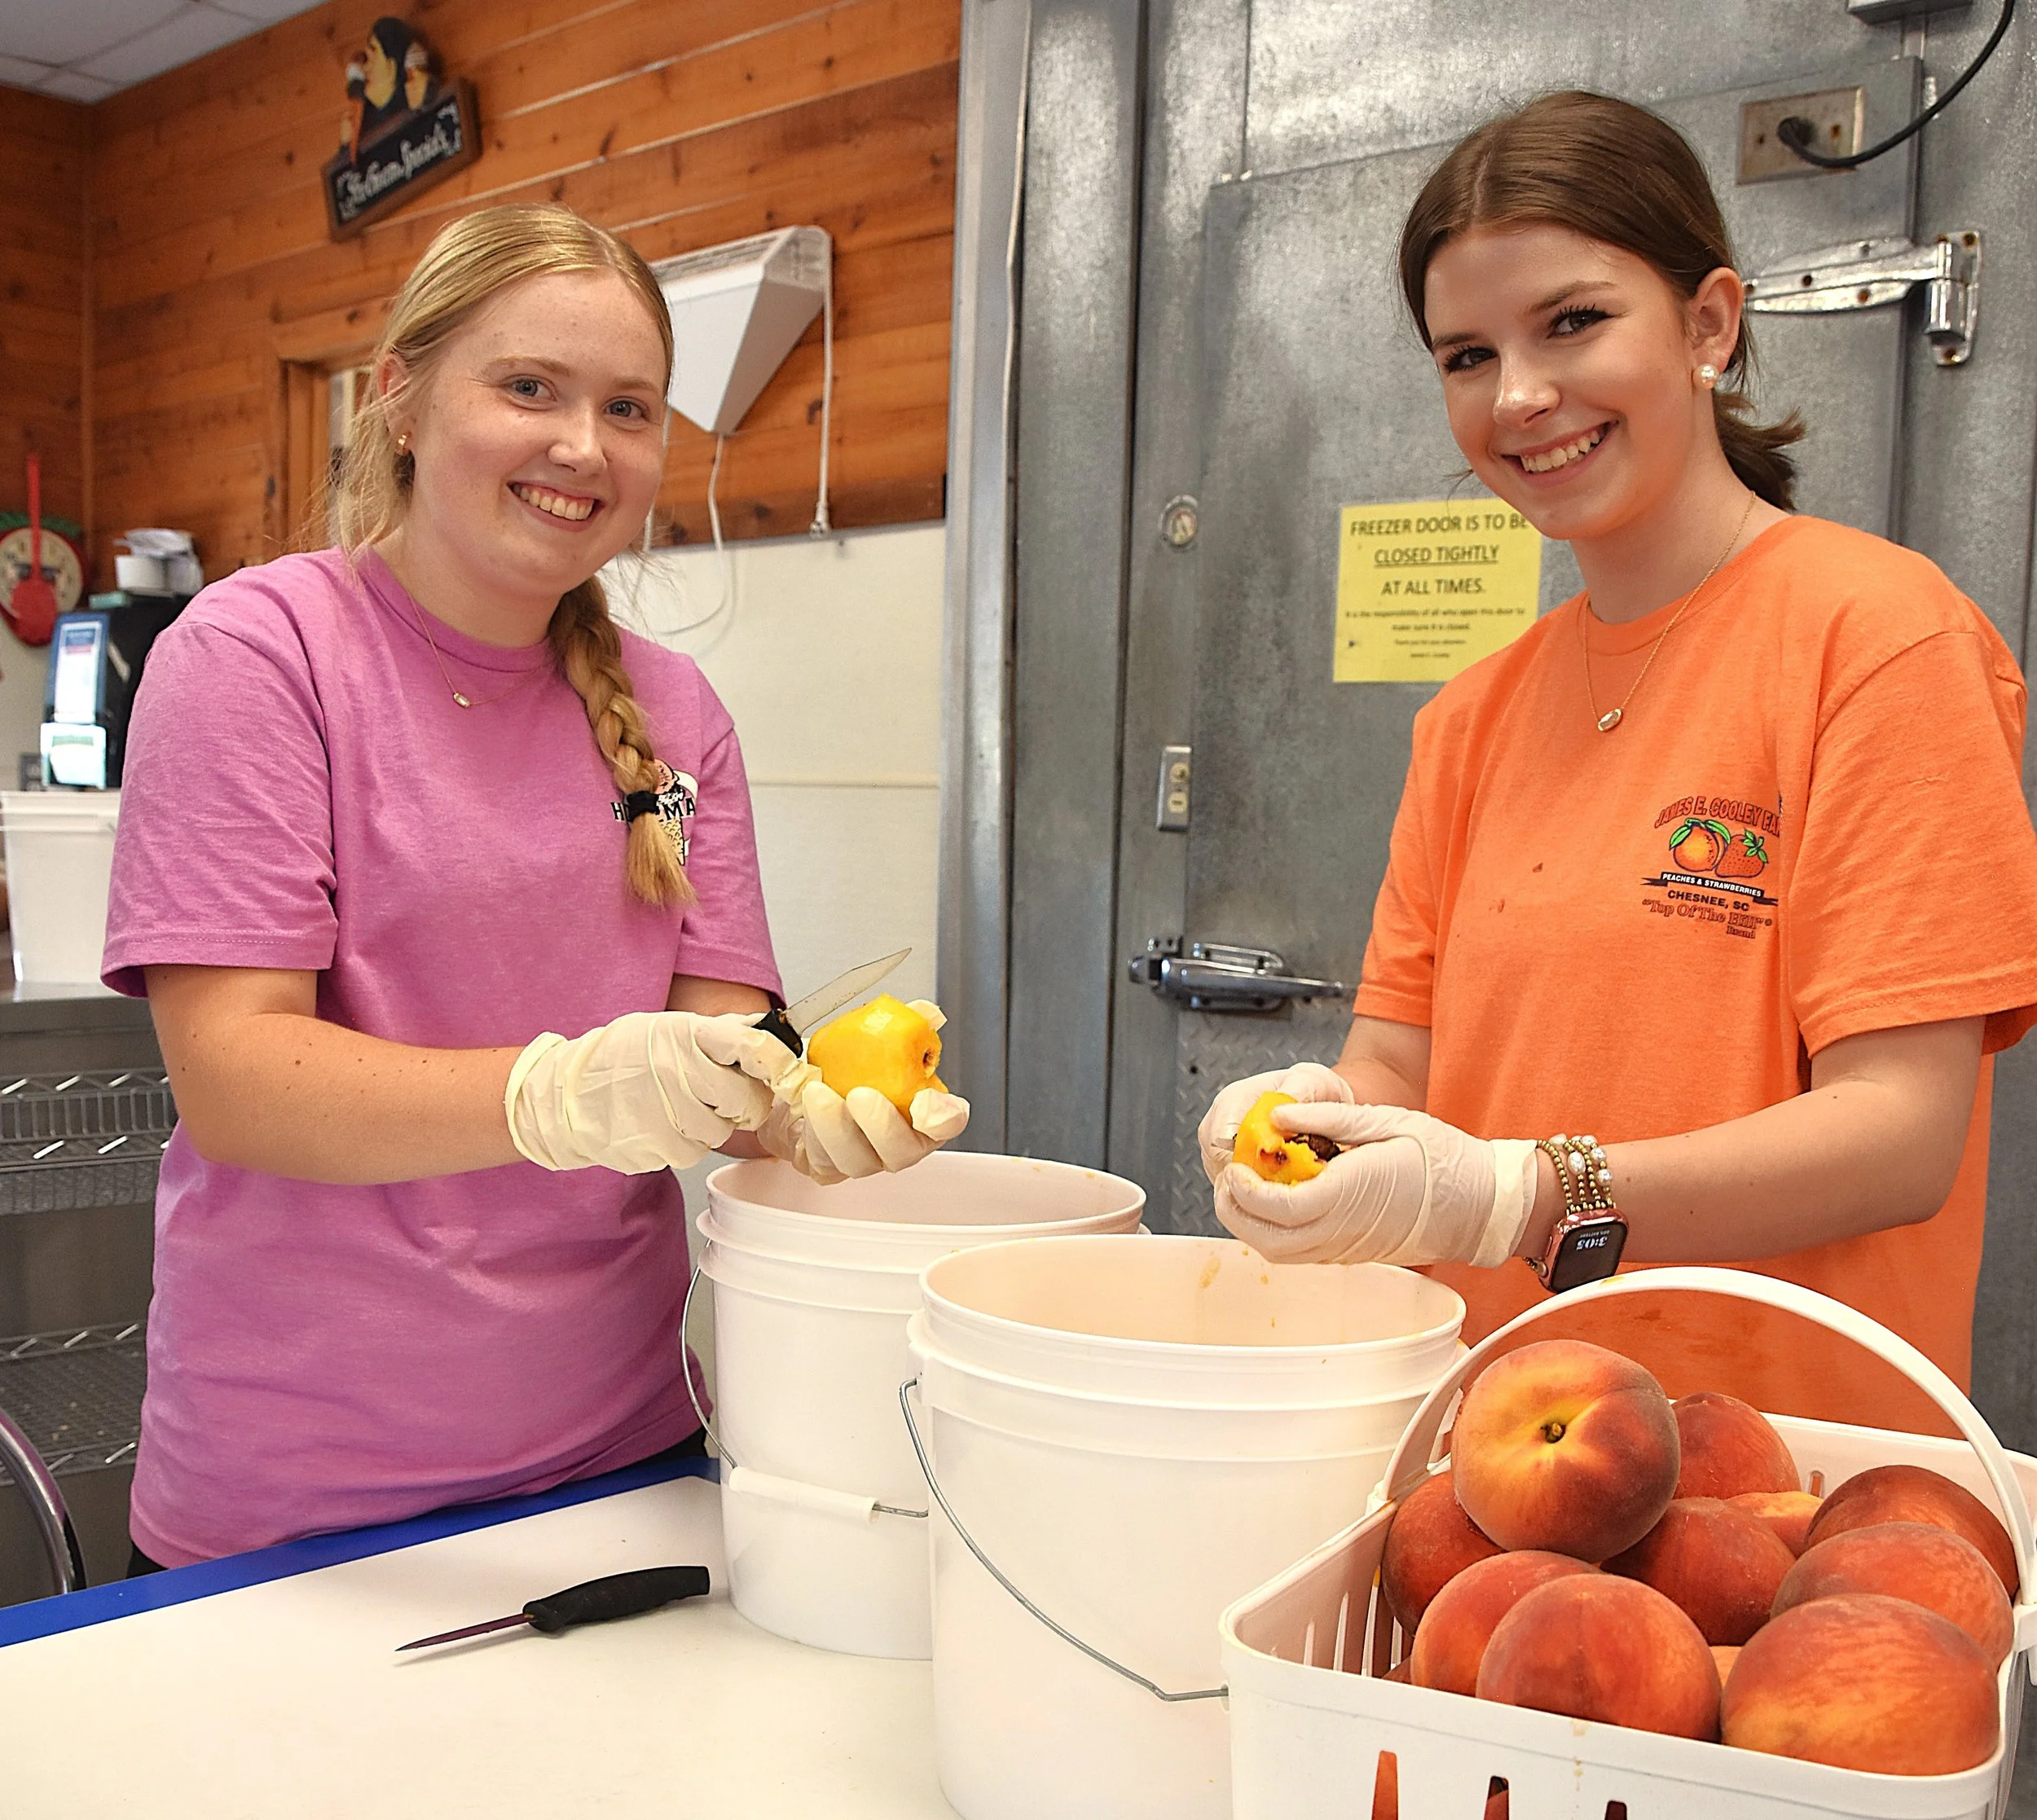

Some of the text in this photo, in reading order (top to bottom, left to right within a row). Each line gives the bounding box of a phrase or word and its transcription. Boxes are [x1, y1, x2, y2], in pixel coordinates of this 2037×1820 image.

[1350, 512, 1528, 536] FREEZER DOOR IS TO BE
[1374, 544, 1500, 564] CLOSED TIGHTLY
[1380, 577, 1486, 597] AT ALL TIMES.
[1654, 795, 1780, 838] JAMES E. COOLEY FA
[1661, 873, 1762, 898] PEACHES & STRAWBERRIES
[1667, 890, 1749, 912] CHESNEE, SC
[1676, 902, 1696, 917] Of
[1698, 904, 1727, 923] The
[1576, 1235, 1608, 1251] 3:05
